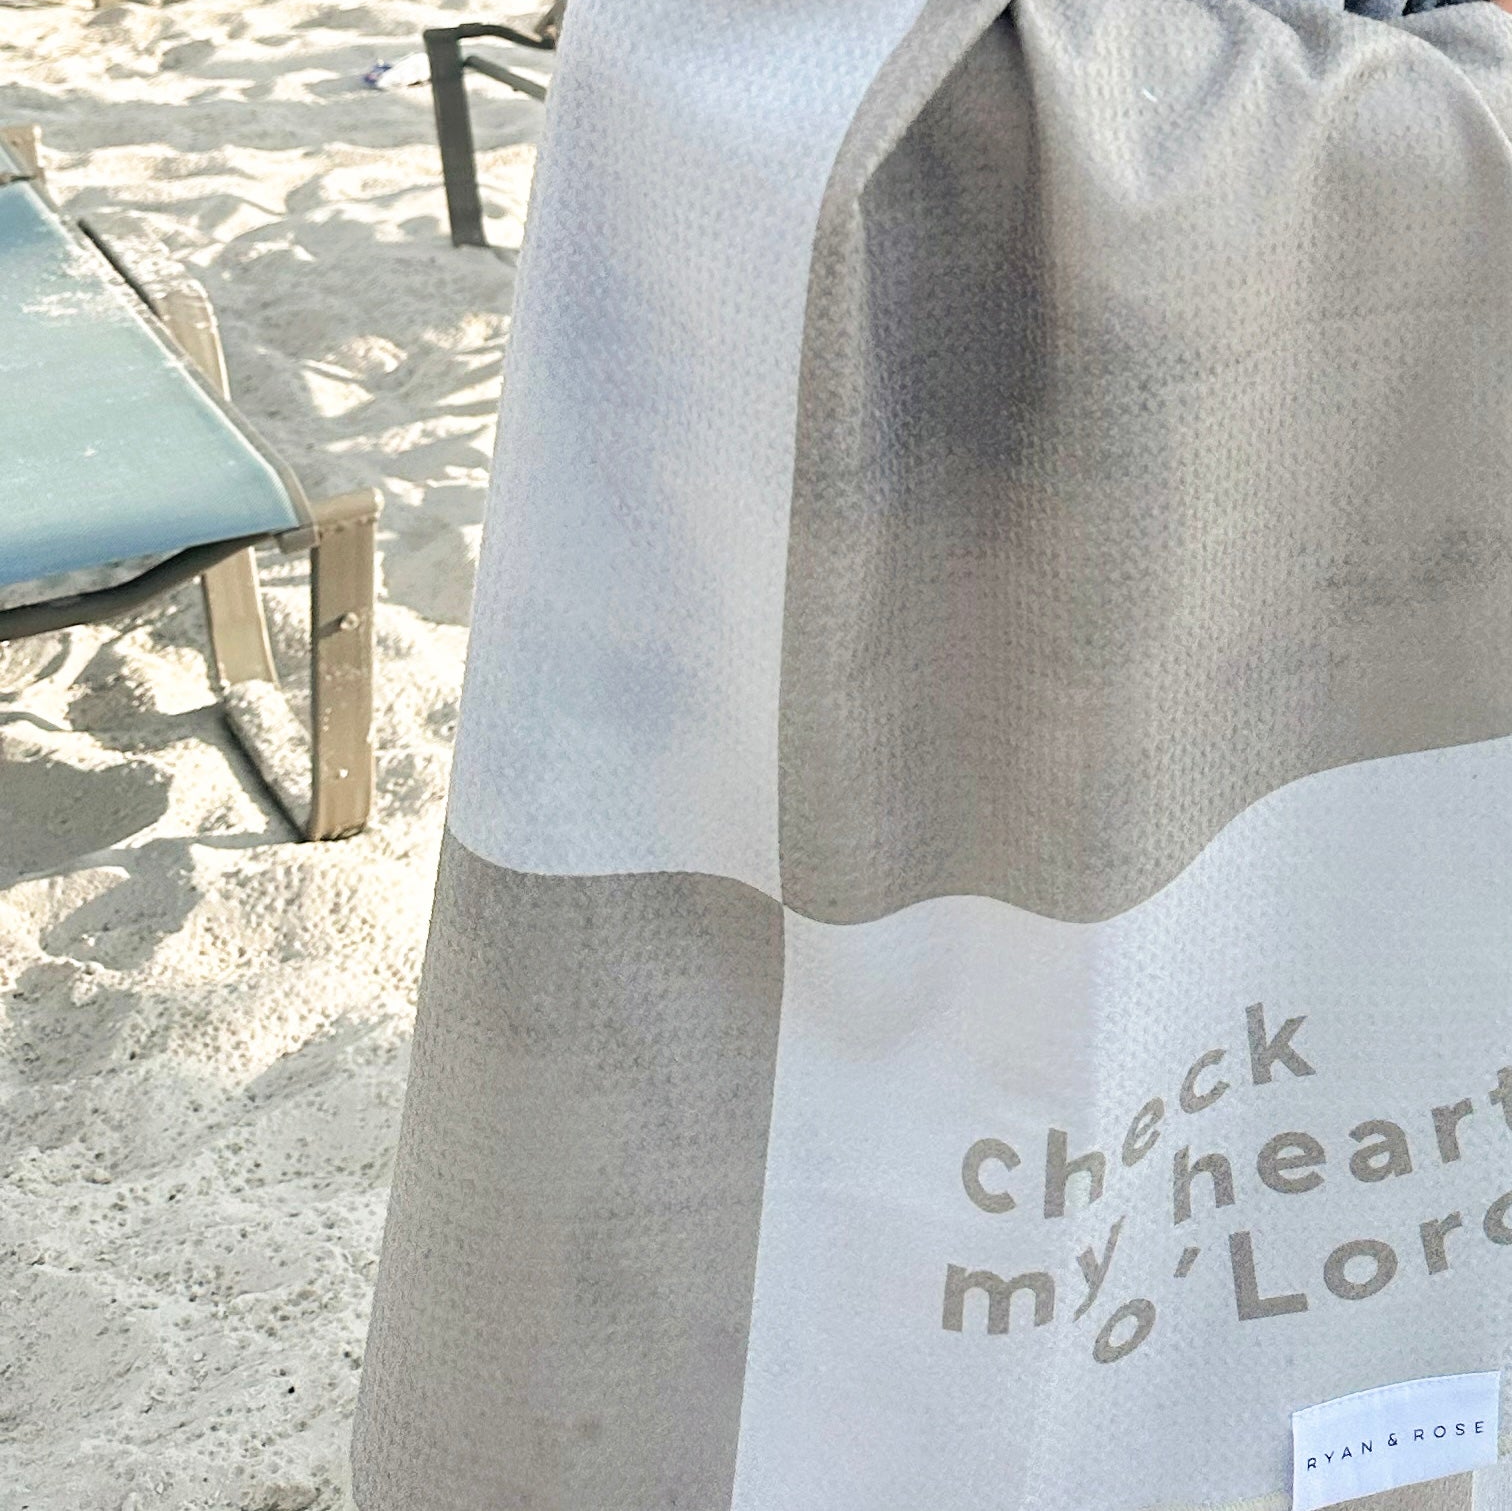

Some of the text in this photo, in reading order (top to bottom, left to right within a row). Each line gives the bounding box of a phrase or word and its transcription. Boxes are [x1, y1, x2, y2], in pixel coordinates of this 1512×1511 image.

[961, 1001, 1316, 1219] check
[941, 1215, 1125, 1335] my
[1307, 1420, 1485, 1471] RYAN & ROSE
